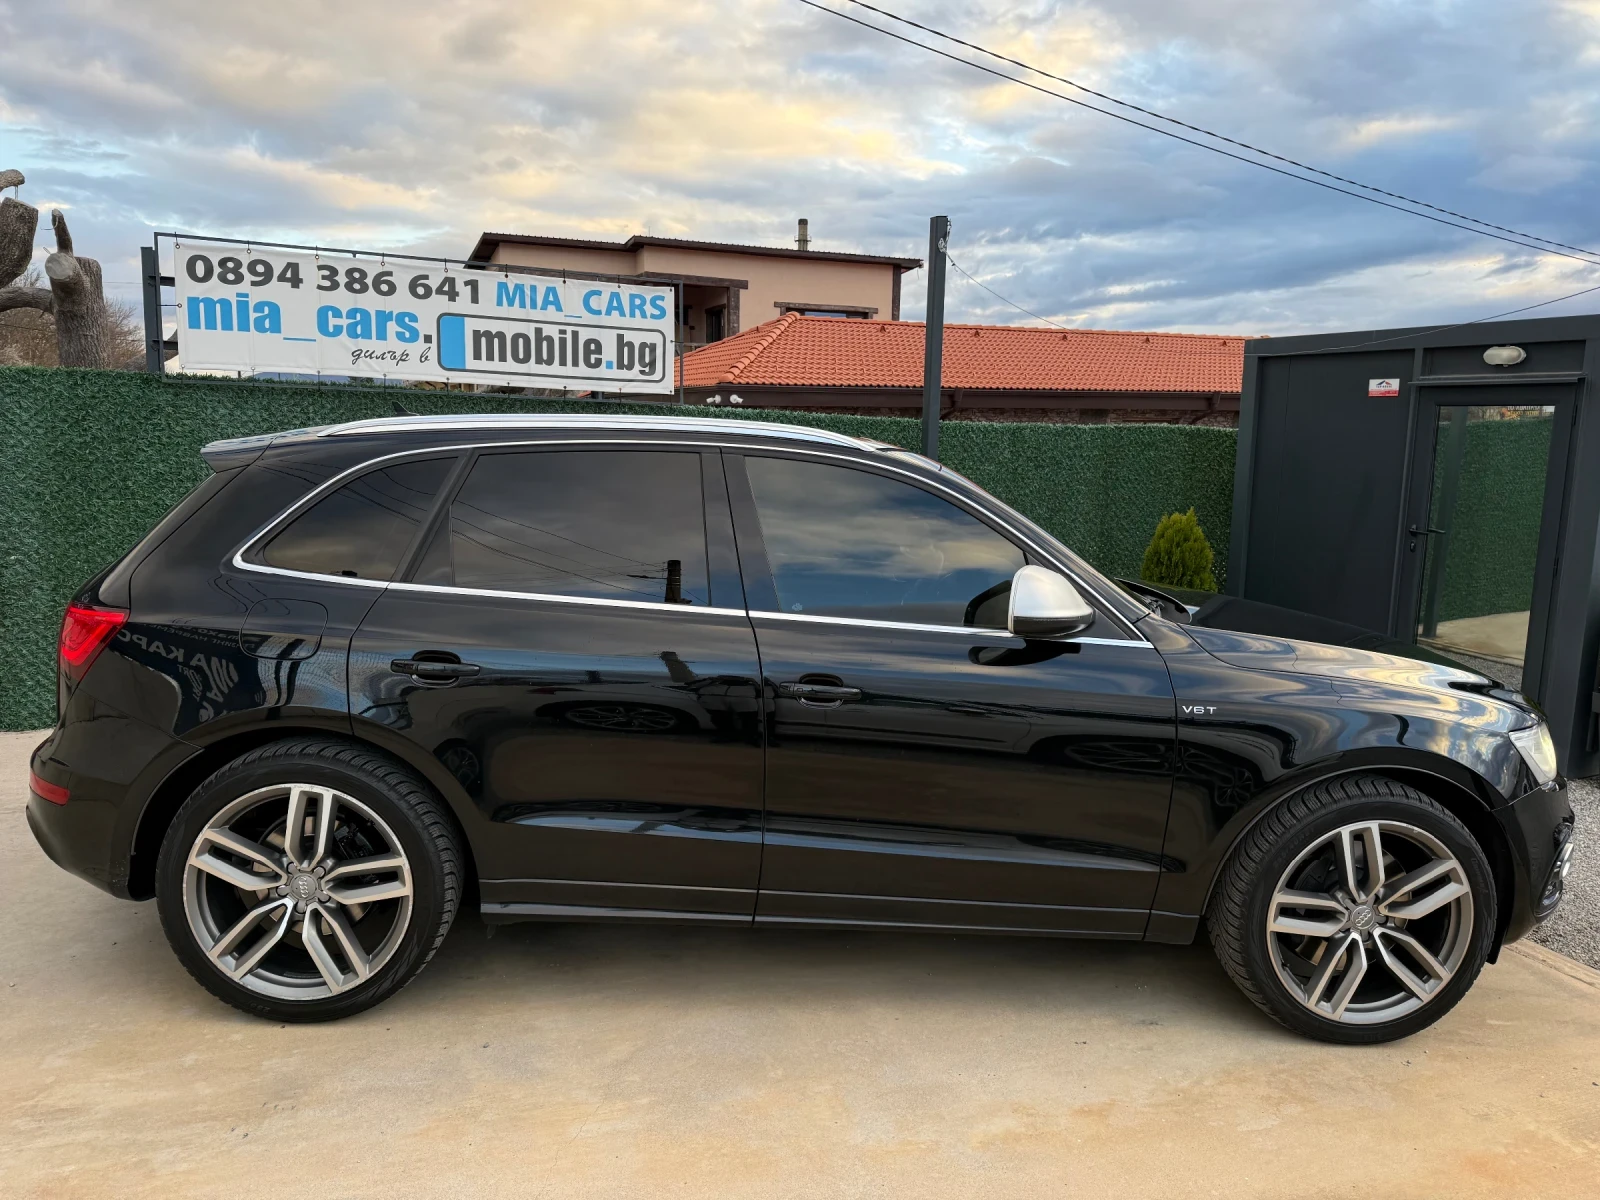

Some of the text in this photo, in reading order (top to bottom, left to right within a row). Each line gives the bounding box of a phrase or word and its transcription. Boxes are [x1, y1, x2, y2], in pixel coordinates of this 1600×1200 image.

[185, 254, 479, 304] 0894 386 641
[496, 281, 667, 320] MIA_CARS
[351, 346, 432, 367] дилър в
[472, 326, 657, 377] mobile.bg
